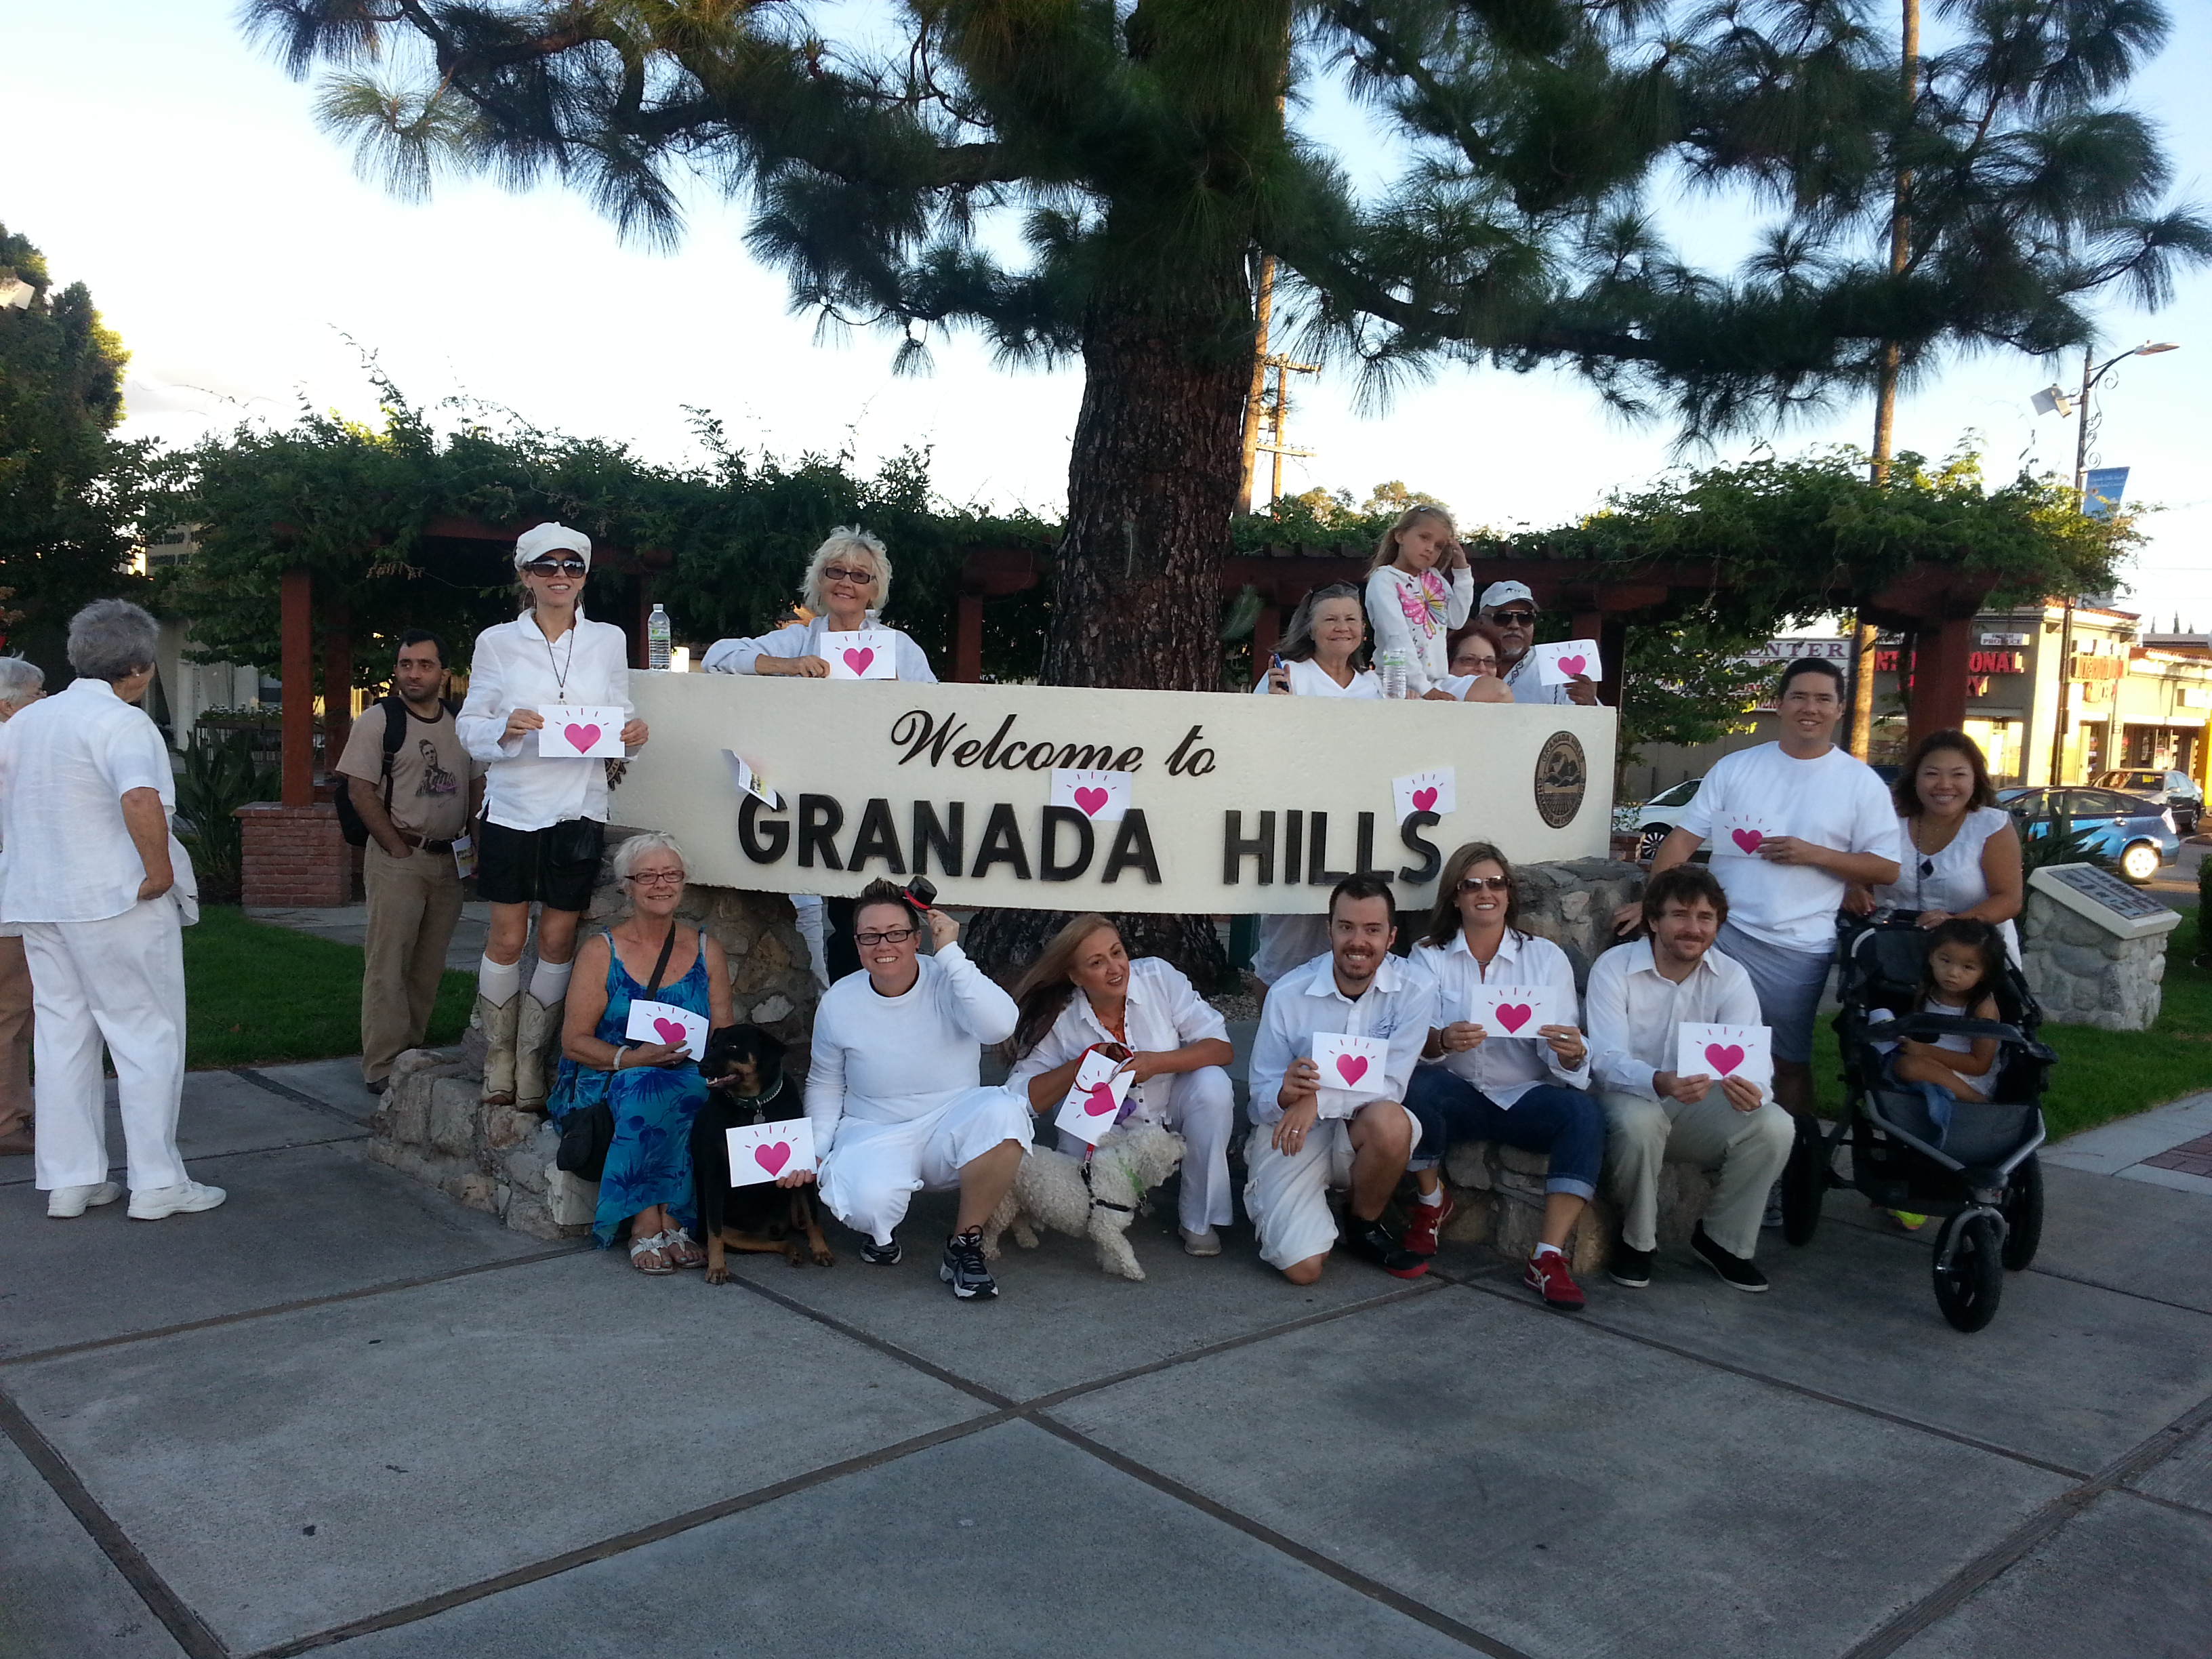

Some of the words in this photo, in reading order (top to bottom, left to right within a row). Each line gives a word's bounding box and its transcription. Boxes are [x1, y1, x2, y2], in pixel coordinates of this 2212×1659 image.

[1744, 643, 1845, 657] ENTER
[890, 709, 1144, 773] Welcome
[1164, 724, 1216, 777] to
[1541, 733, 1570, 762] GRANADA
[1572, 736, 1585, 764] HILLS
[737, 792, 1163, 884] GRANADA
[1223, 808, 1442, 886] HILLS
